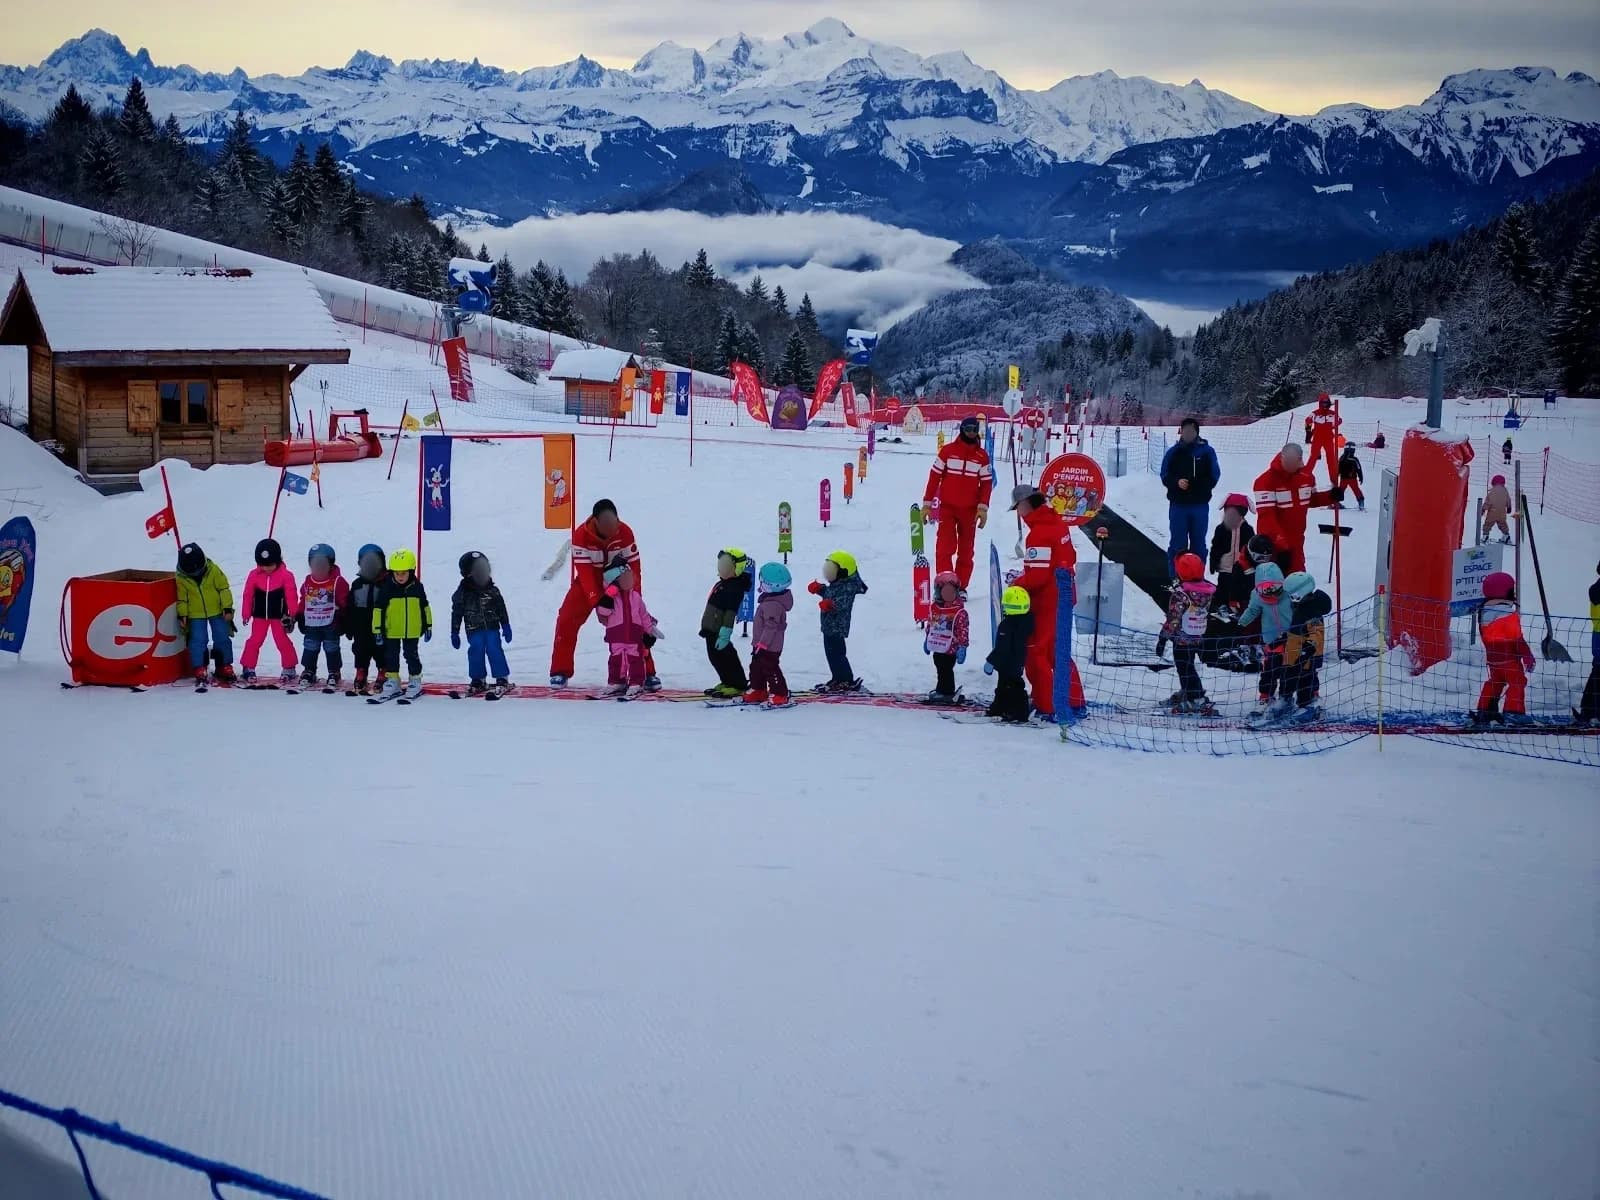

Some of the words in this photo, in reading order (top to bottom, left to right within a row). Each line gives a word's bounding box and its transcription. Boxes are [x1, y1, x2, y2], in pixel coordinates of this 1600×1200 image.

[1061, 466, 1089, 476] JARDIN
[1053, 473, 1094, 483] D'ENFANTS
[931, 497, 939, 509] 3
[911, 522, 921, 536] 2
[1463, 562, 1493, 574] ESPACE
[1455, 576, 1475, 587] P'TIT
[919, 580, 930, 604] 1
